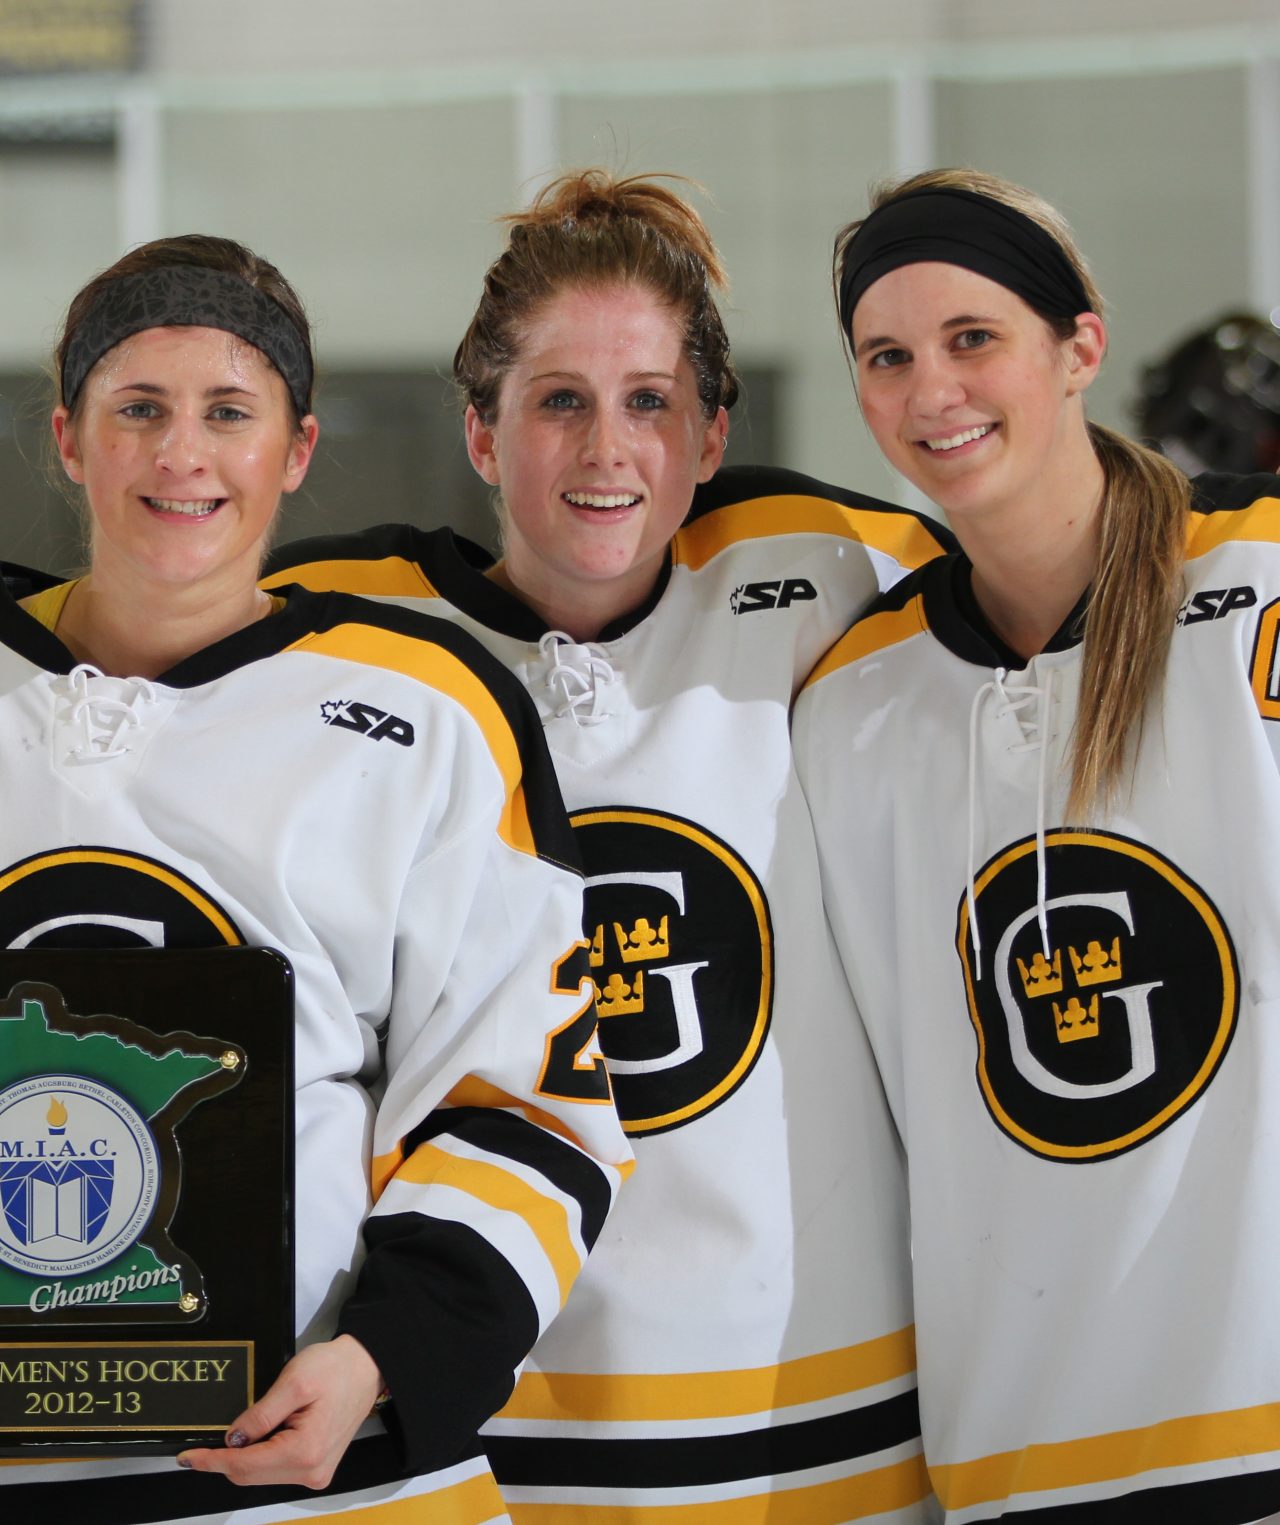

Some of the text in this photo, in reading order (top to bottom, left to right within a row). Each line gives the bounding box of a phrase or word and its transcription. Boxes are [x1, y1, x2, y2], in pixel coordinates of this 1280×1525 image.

[994, 891, 1163, 1099] G
[7, 1084, 36, 1100] THOMAS
[37, 1081, 76, 1089] AUGSBURG
[78, 1084, 105, 1099] BETHEL
[105, 1095, 135, 1124] CARLETON
[132, 1123, 152, 1164] CONCORDIA
[0, 1139, 117, 1158] M.I.A.C.
[13, 1255, 47, 1270] BENEDICT
[49, 1258, 96, 1271] MACALESTER
[96, 1239, 126, 1262] HAMLINE
[29, 1264, 181, 1313] Champions
[98, 1360, 231, 1382] HOCKEY
